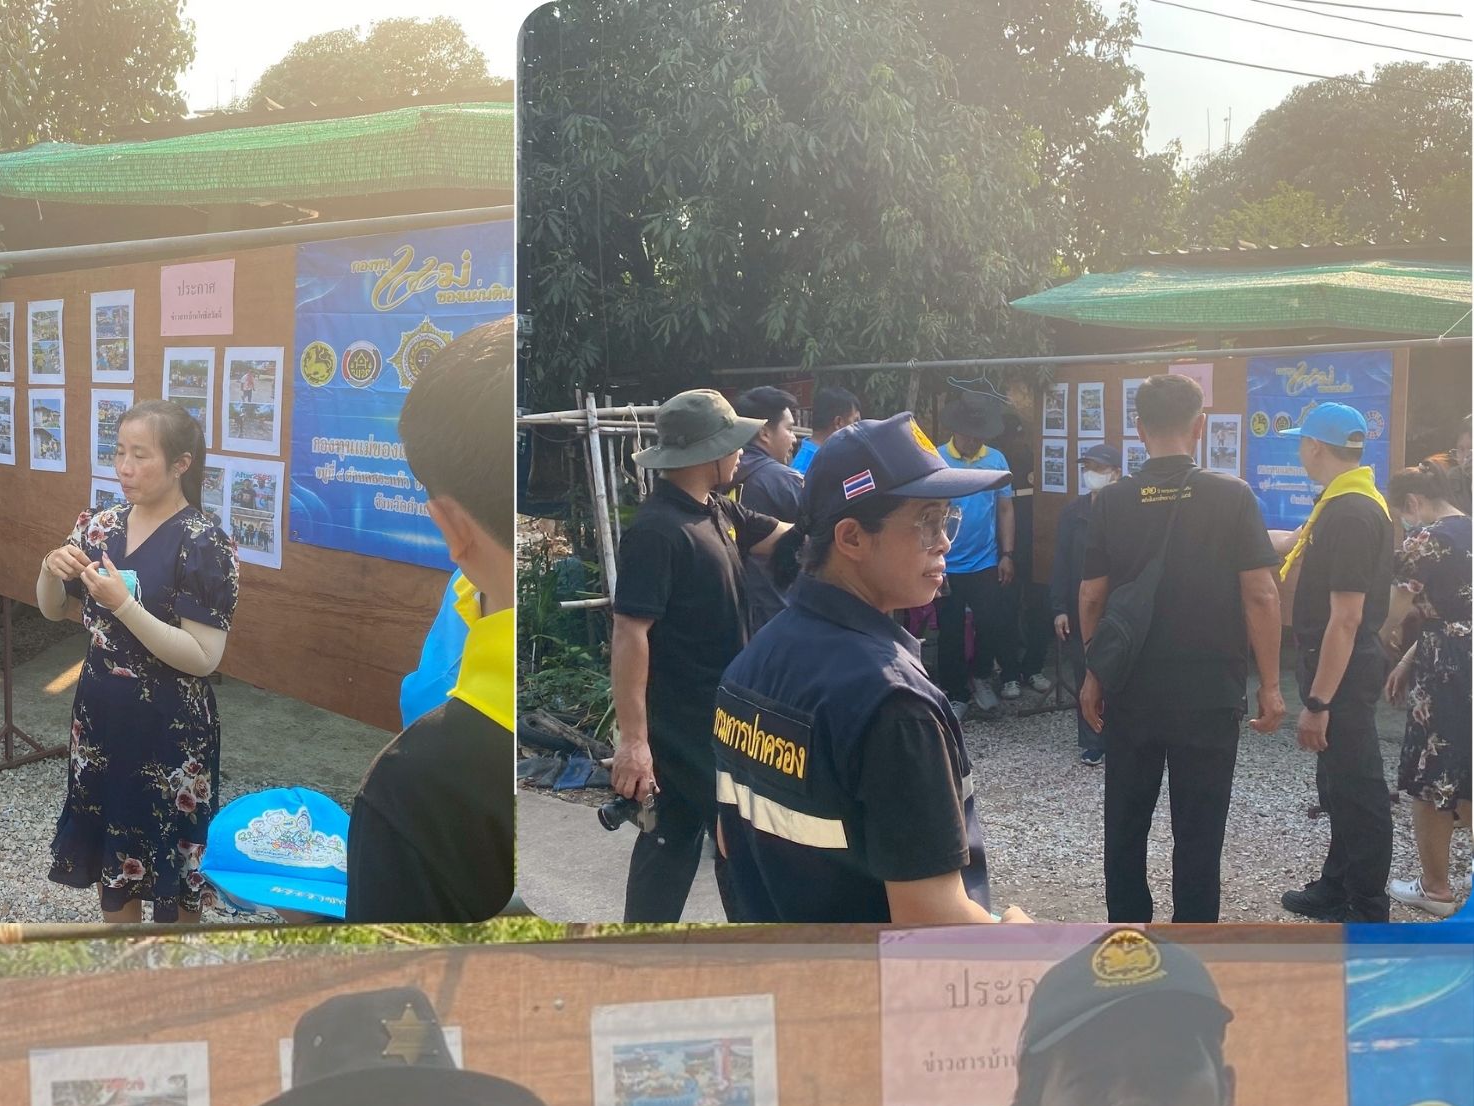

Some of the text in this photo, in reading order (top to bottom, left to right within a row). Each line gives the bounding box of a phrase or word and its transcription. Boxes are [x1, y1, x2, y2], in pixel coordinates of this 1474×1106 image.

[177, 279, 216, 297] ประกาศ
[713, 706, 807, 779] กรมการปกครอง
